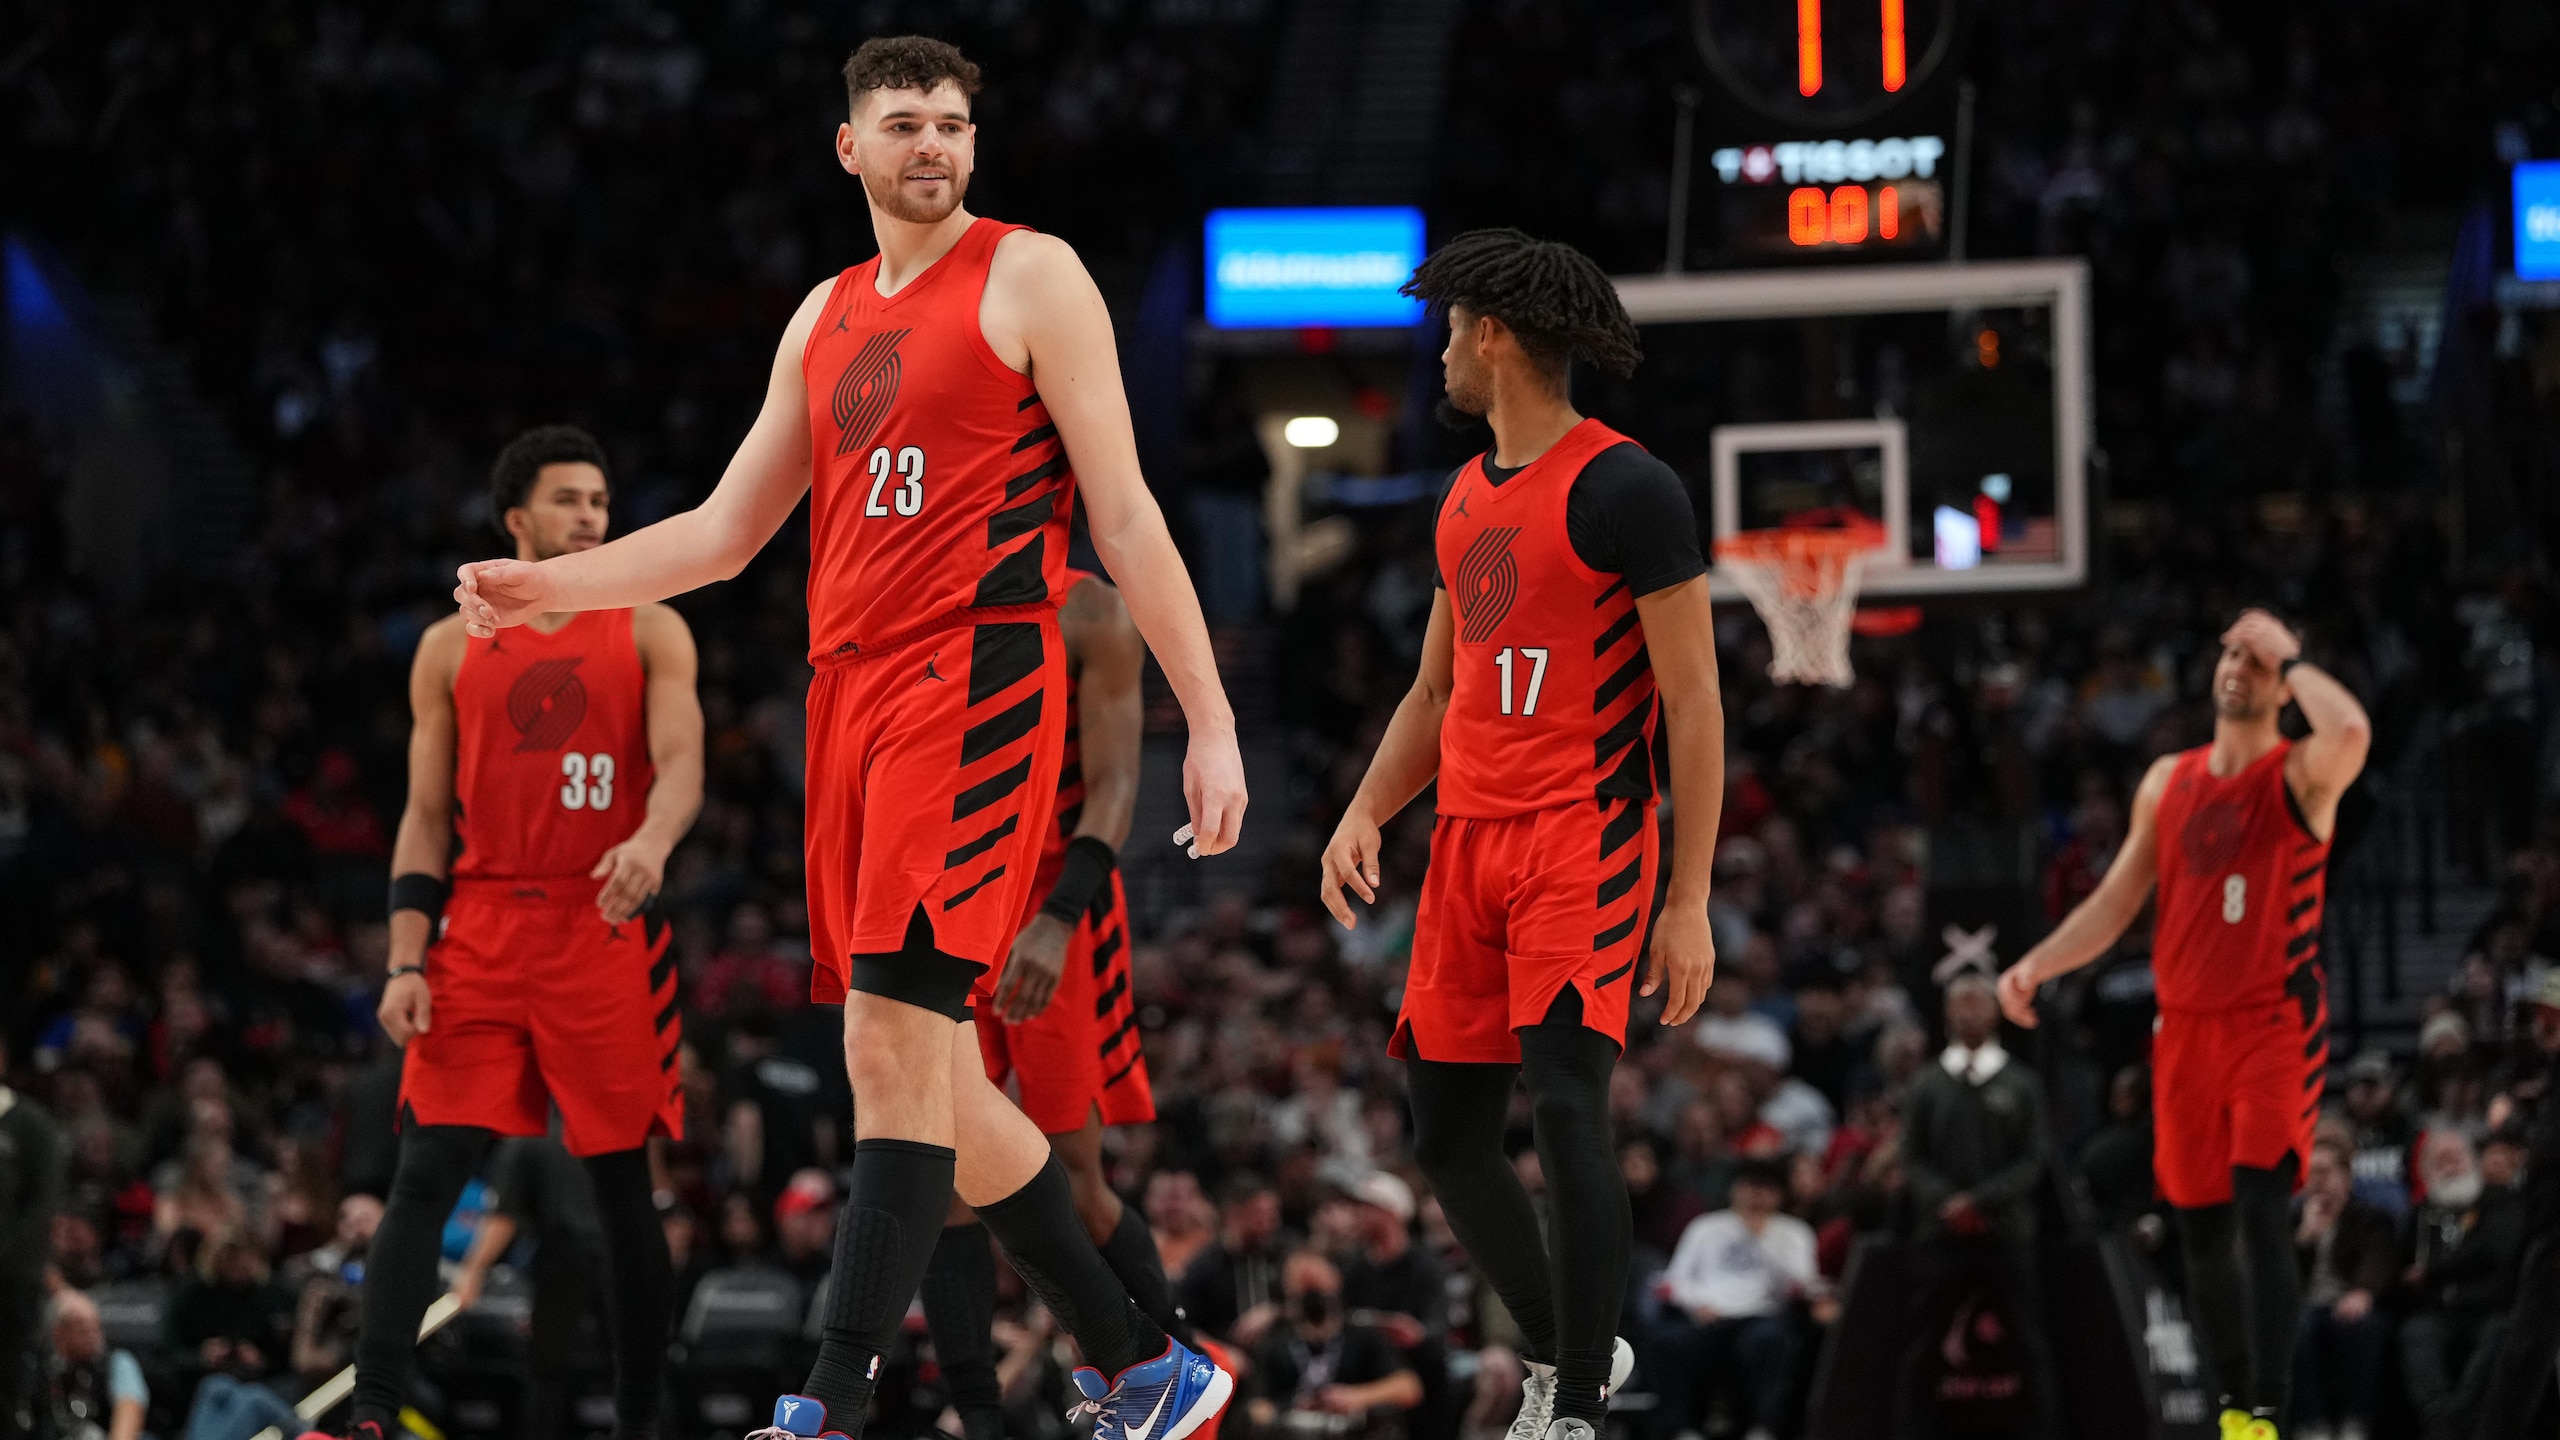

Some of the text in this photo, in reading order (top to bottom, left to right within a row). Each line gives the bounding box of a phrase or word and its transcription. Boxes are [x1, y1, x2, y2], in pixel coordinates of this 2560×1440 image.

[864, 445, 925, 518] 23
[1494, 646, 1550, 717] 17
[560, 751, 616, 812] 33
[2221, 872, 2247, 925] 8
